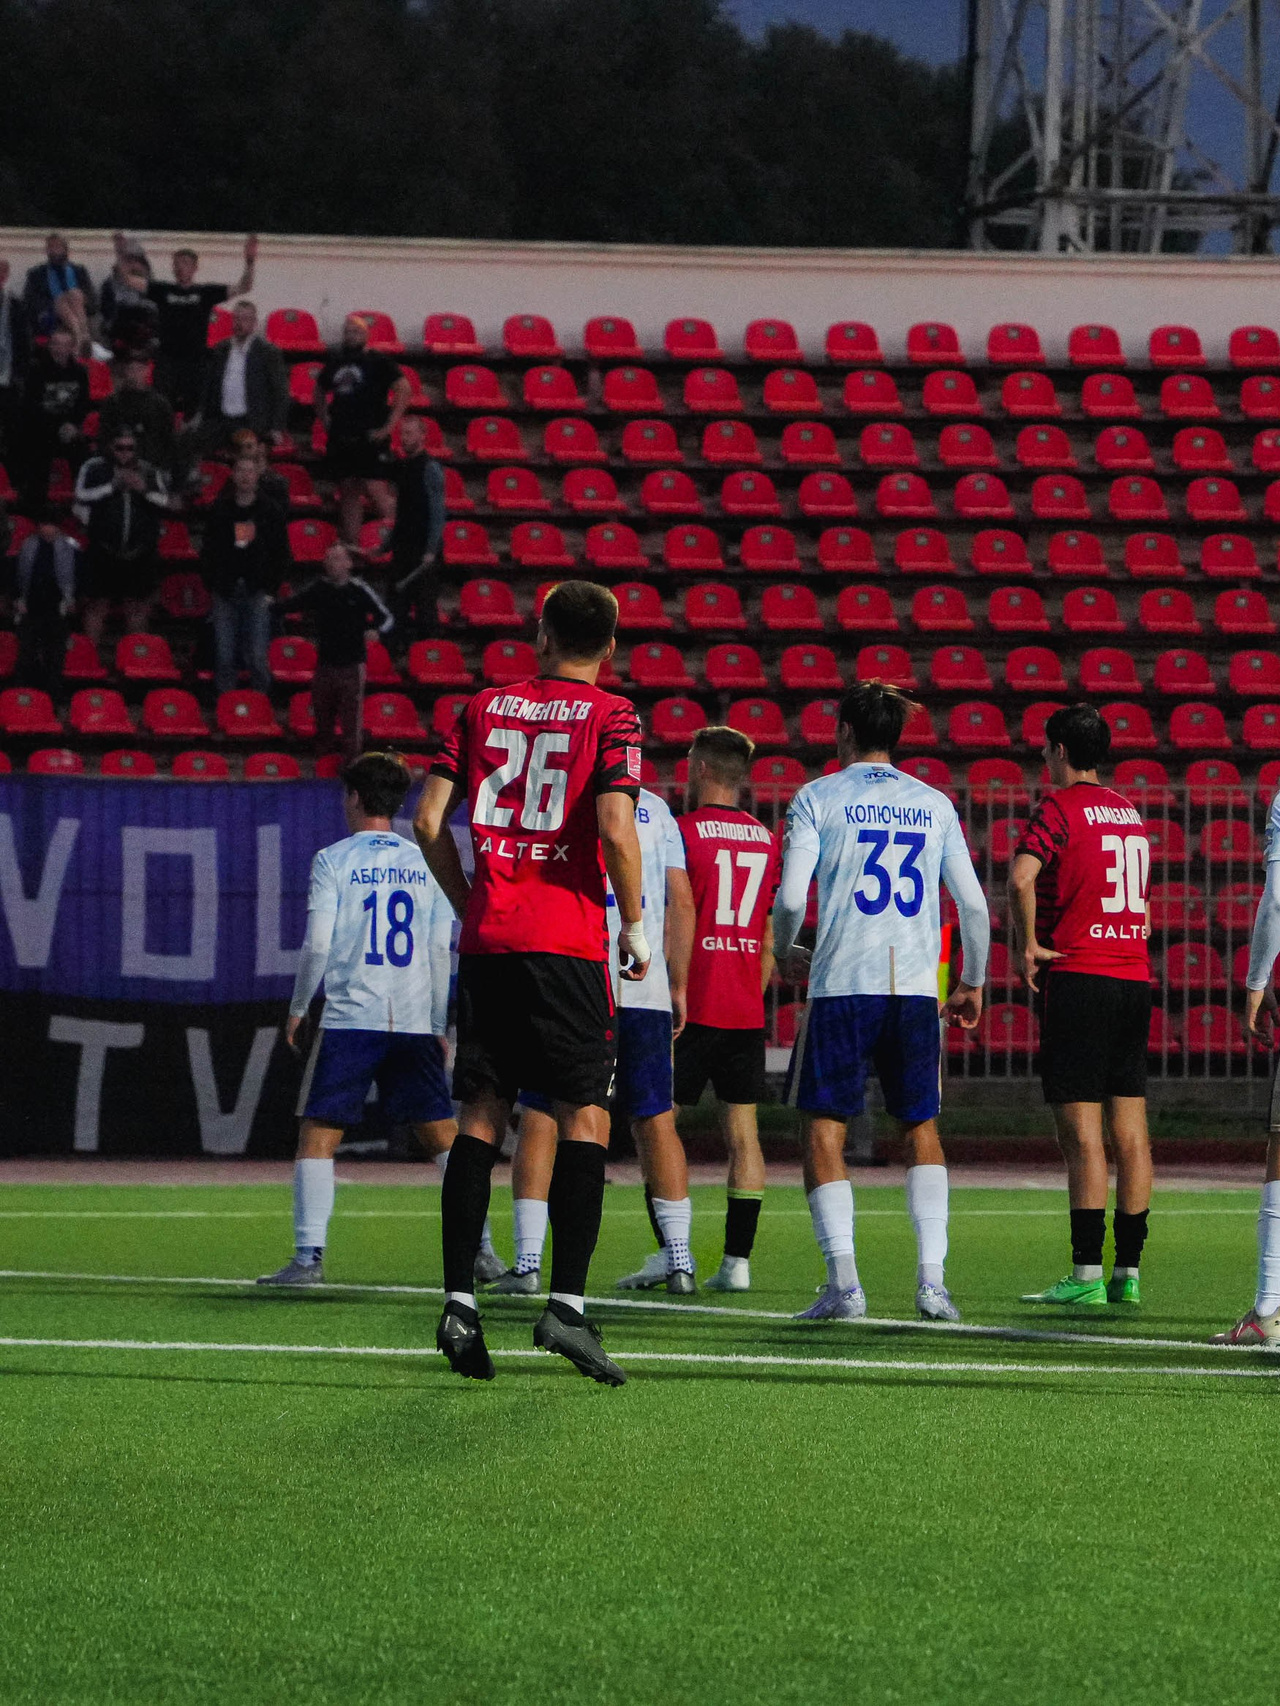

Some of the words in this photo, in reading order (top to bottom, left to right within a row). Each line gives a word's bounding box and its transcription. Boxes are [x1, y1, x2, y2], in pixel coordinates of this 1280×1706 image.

[486, 695, 593, 722] КЛЕМЕНТЬЕВ
[472, 728, 570, 831] 26
[844, 804, 932, 828] КОЛЮЧКИН
[473, 836, 569, 862] ALTEX
[854, 829, 926, 917] 33
[1100, 835, 1150, 913] 30
[350, 867, 428, 887] АБДУЛКИН
[715, 849, 768, 927] 17
[363, 890, 414, 967] 18
[702, 936, 762, 953] GALTE
